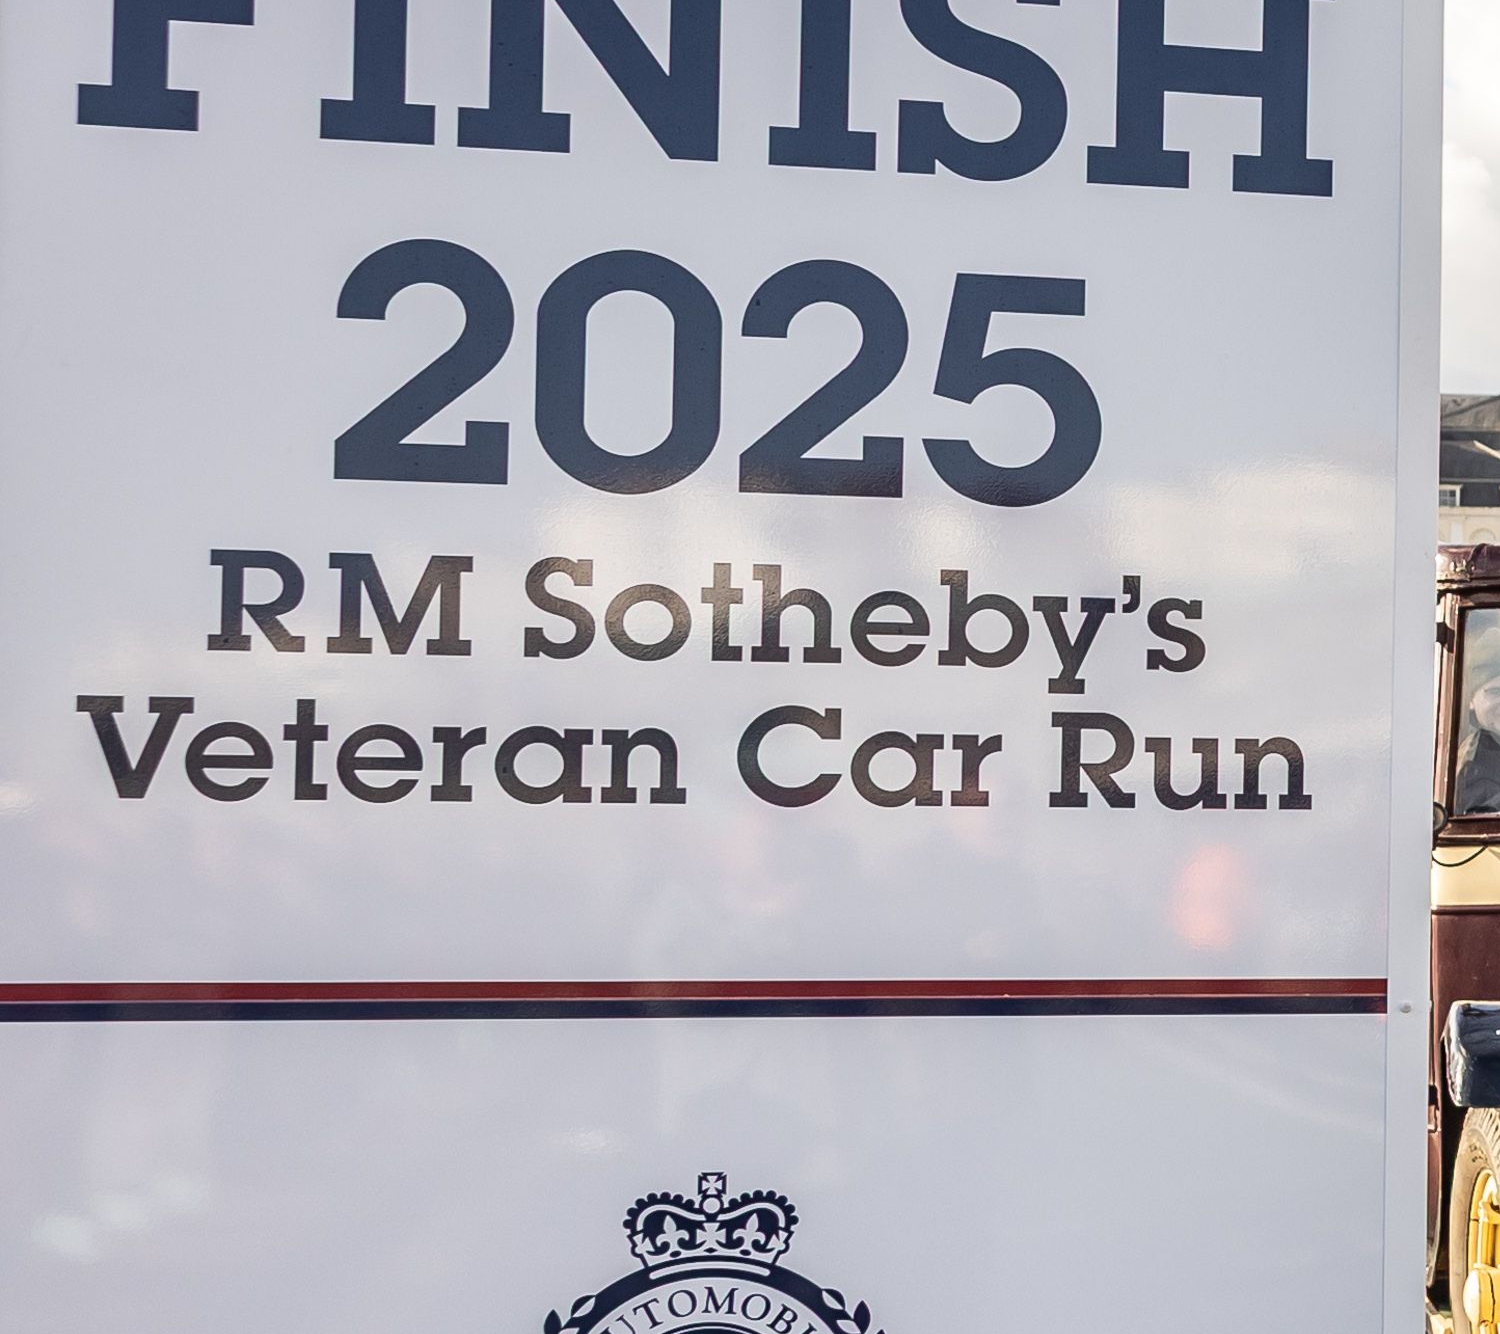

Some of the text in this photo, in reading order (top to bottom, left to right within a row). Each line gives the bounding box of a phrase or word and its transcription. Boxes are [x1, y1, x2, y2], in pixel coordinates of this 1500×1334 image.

[334, 238, 1103, 507] 2025
[206, 551, 1207, 695] RM Sotheby's
[76, 696, 1311, 811] Veteran Car Run
